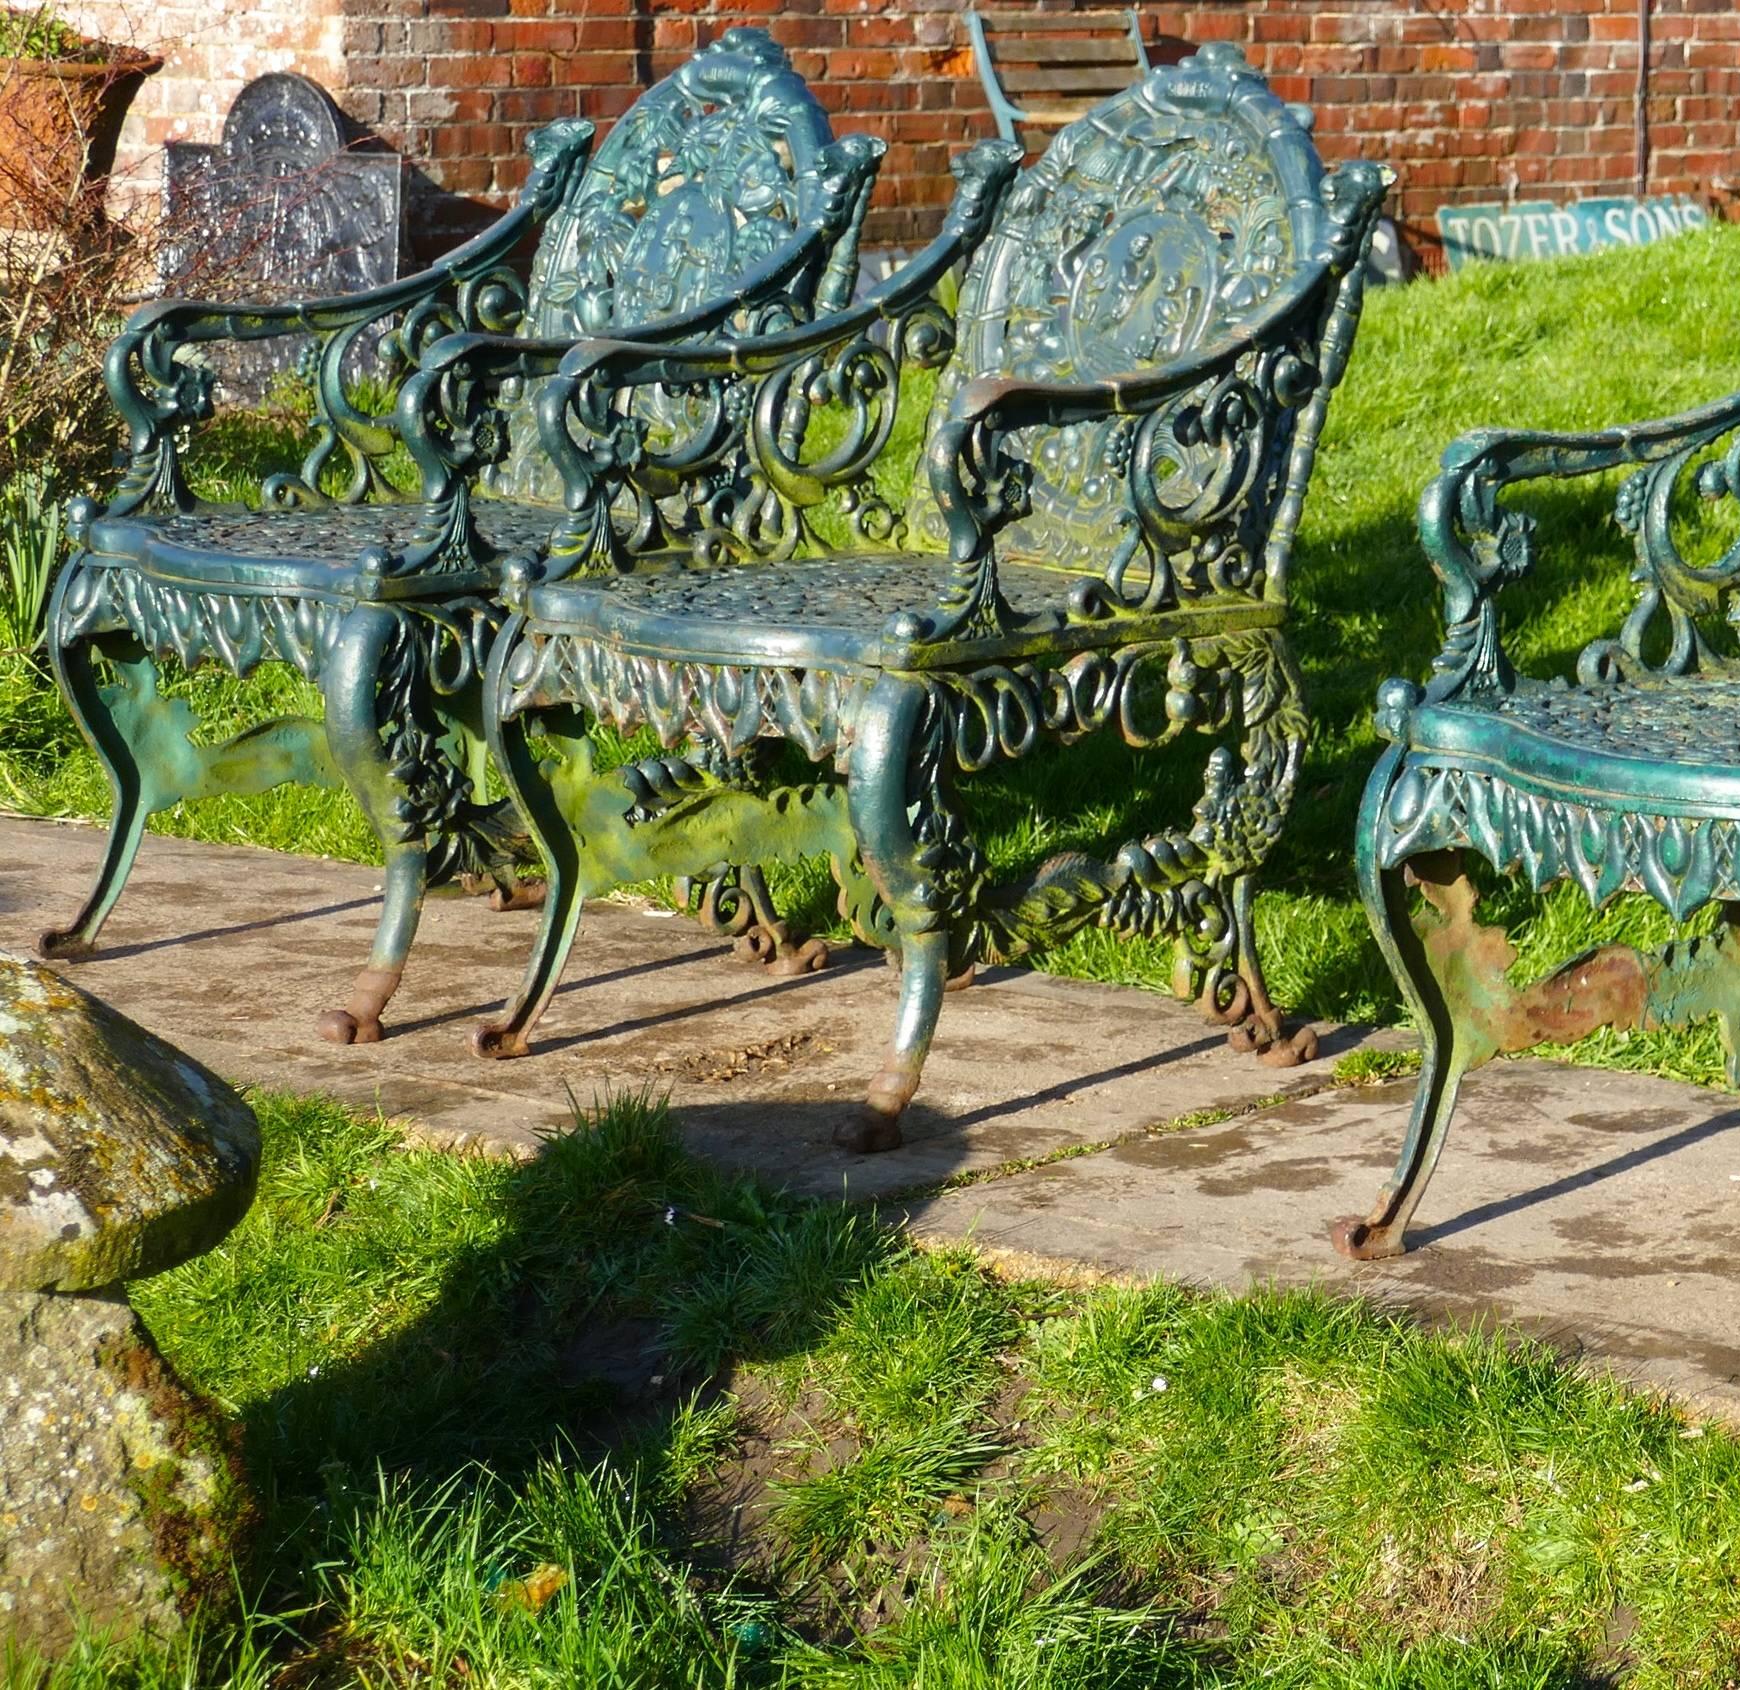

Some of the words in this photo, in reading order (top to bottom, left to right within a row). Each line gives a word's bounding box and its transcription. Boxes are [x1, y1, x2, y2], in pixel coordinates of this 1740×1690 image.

[1448, 211, 1579, 259] TOZER
[1585, 216, 1612, 251] &
[1604, 204, 1705, 246] SONS
